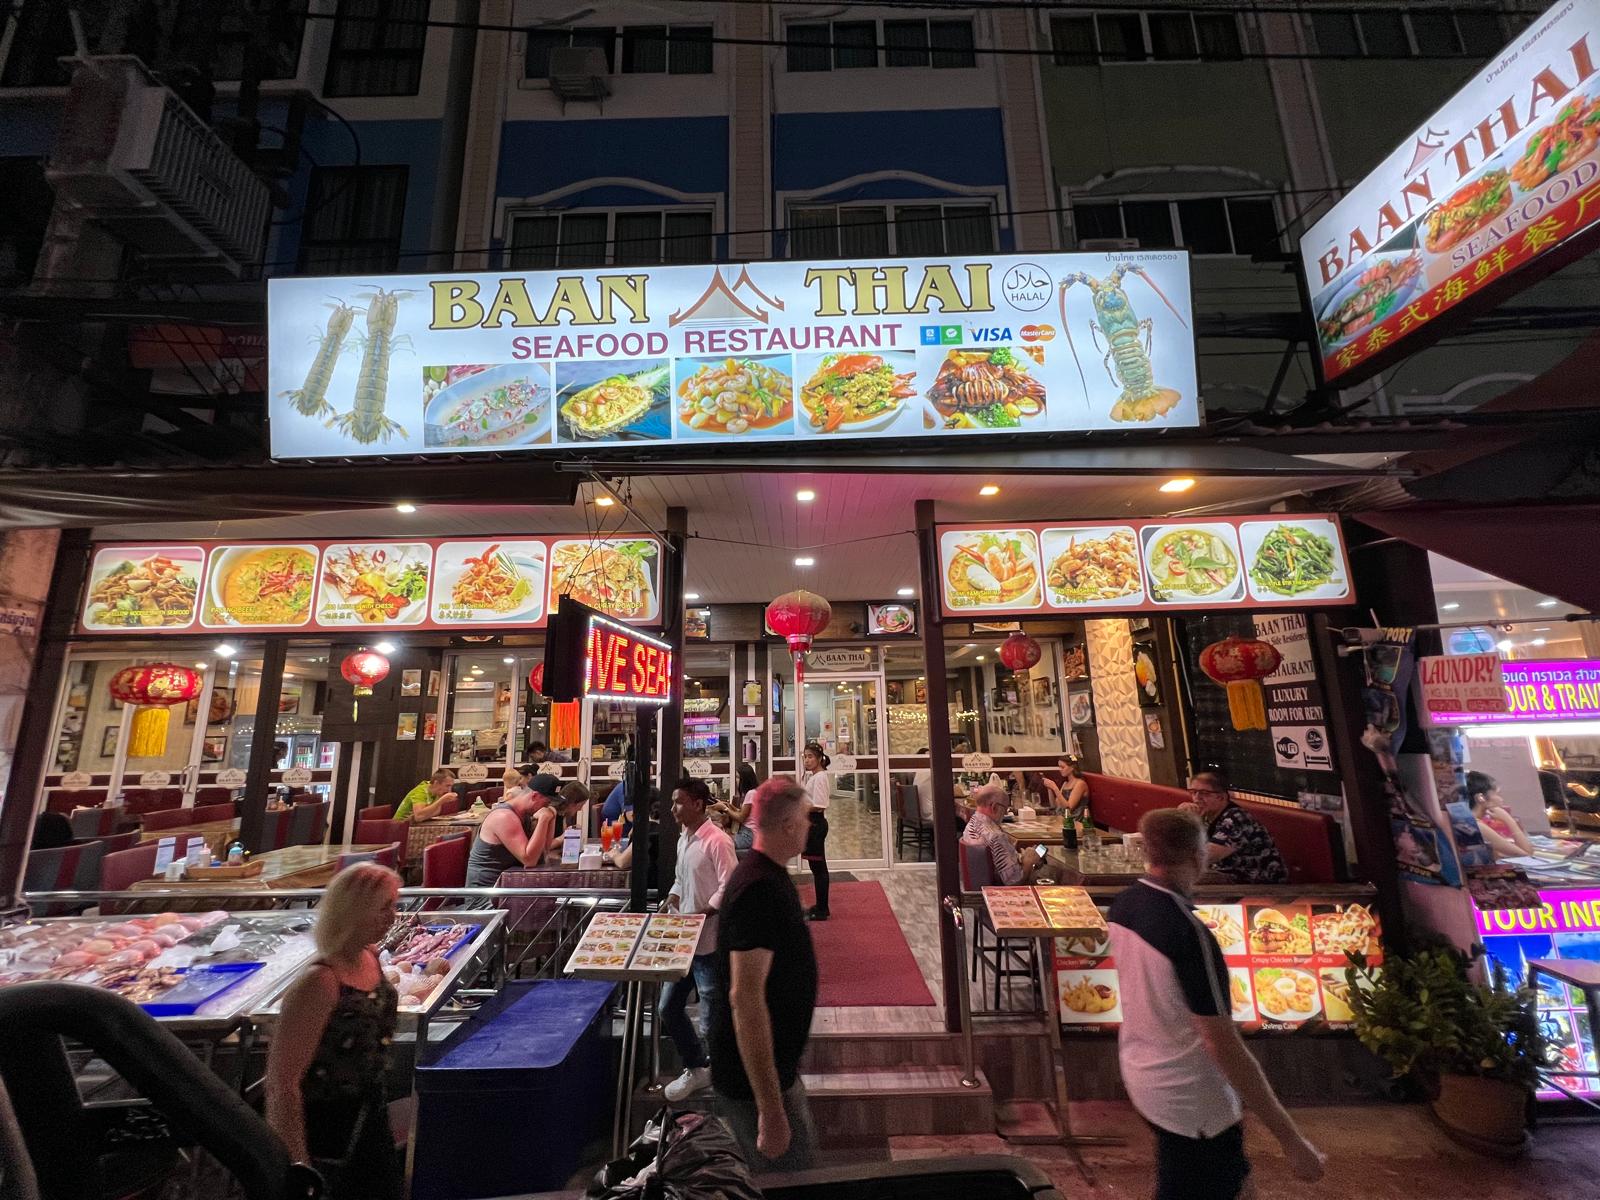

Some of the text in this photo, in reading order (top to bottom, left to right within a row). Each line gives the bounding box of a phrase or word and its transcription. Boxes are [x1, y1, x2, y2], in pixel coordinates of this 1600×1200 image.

[1318, 31, 1600, 287] BAAN THAI
[1451, 160, 1599, 270] SEAFOOD
[429, 263, 995, 330] BAAN THAI
[1011, 292, 1045, 302] HALAL
[512, 323, 902, 360] SEAFOOD RESTAURANT
[970, 327, 1013, 342] VISA
[1255, 613, 1306, 637] BAAN THAI
[1423, 656, 1496, 684] LAUNDRY
[1532, 671, 1572, 682] ทราเวล
[1272, 687, 1309, 702] LUXURY
[1505, 684, 1541, 712] OUR
[1542, 684, 1556, 711] &
[1554, 682, 1600, 710] TRAV
[1268, 706, 1323, 721] ROOM FOR RENT
[1079, 959, 1097, 967] Wings
[1251, 957, 1270, 965] Crispy
[1293, 956, 1312, 965] Burger
[1082, 1025, 1101, 1033] crispy
[1261, 1023, 1283, 1031] Shrimp
[1328, 1023, 1347, 1031] Spring
